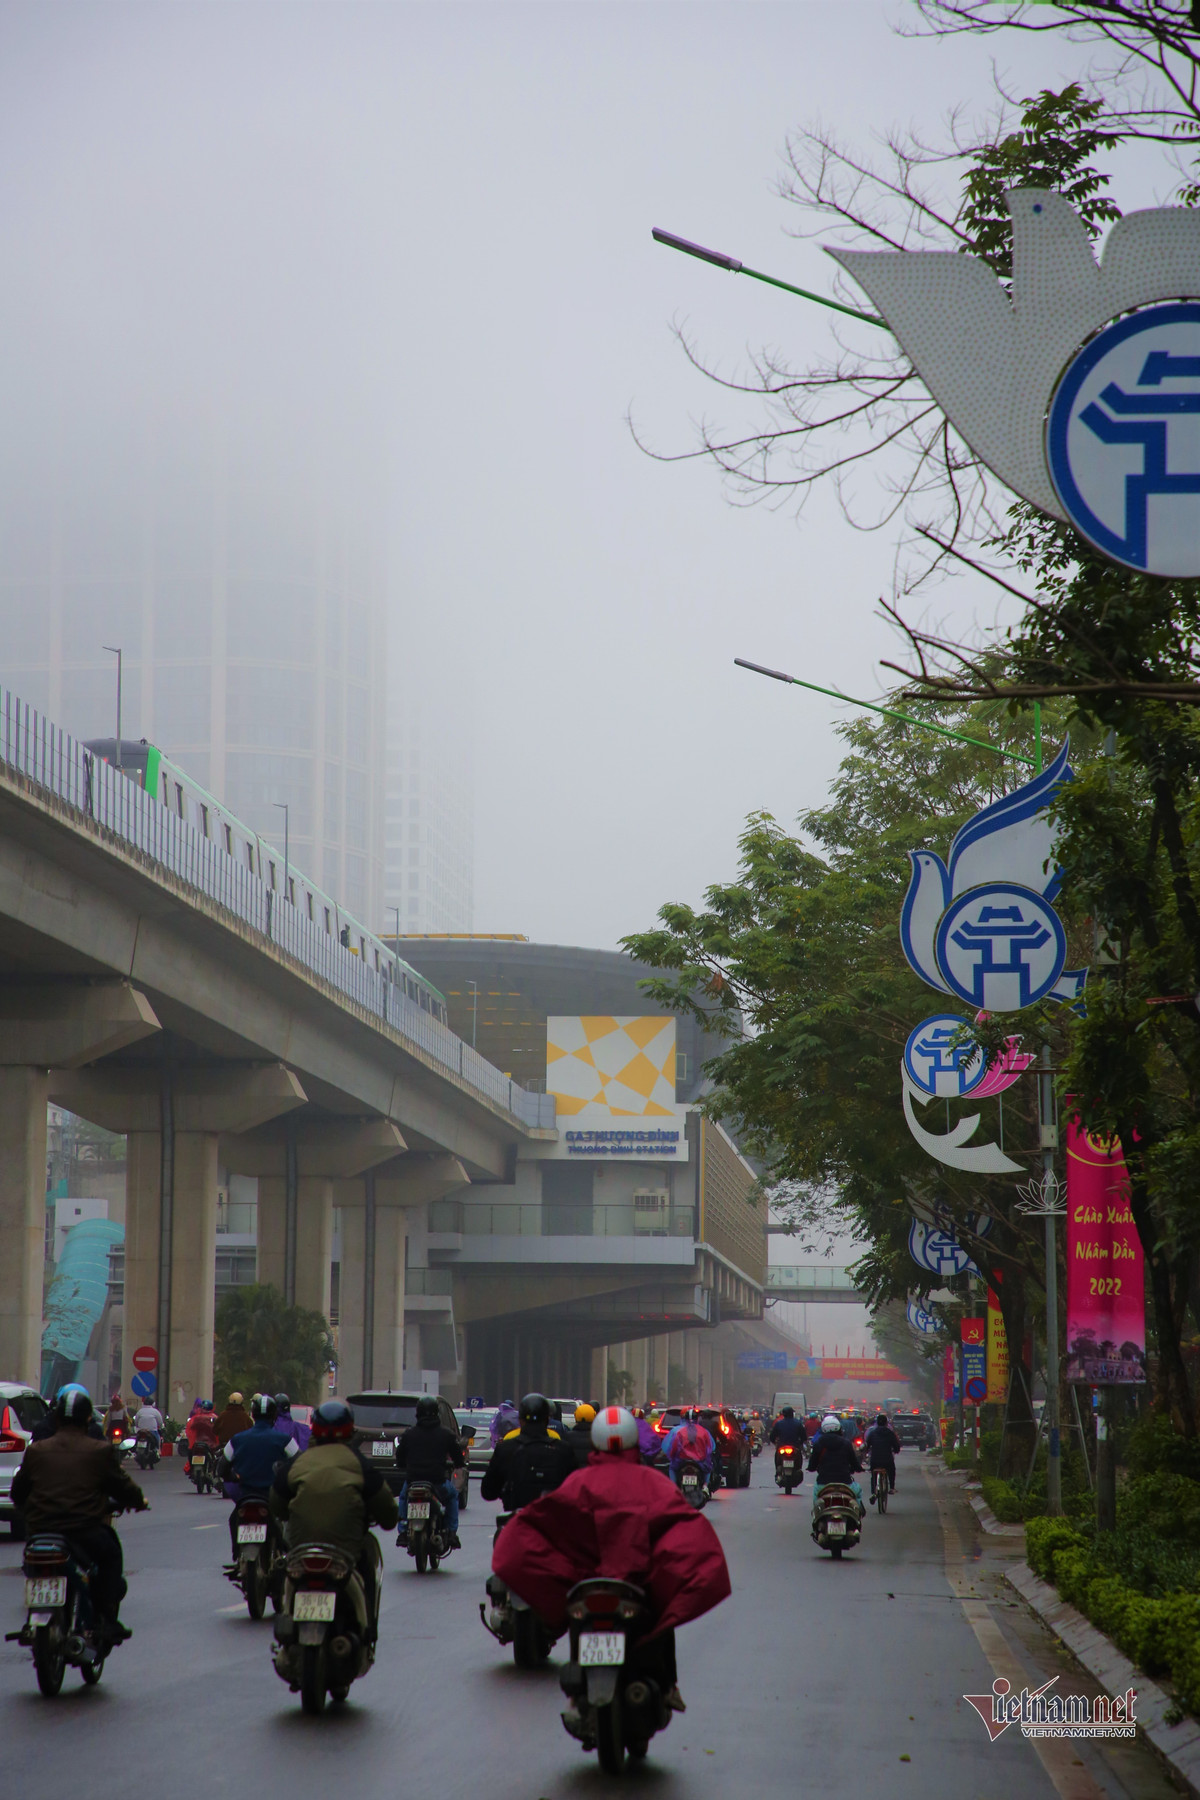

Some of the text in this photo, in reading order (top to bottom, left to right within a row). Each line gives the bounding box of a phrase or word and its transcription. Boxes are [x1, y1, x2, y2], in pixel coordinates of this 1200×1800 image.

[565, 1130, 585, 1142] GA
[635, 1145, 677, 1155] STATION
[1074, 1205, 1103, 1224] Chào
[1075, 1238, 1136, 1260] Nhâm Dần
[1089, 1277, 1122, 1295] 2022
[587, 1633, 617, 1649] 29-V1
[582, 1648, 621, 1664] 520.57
